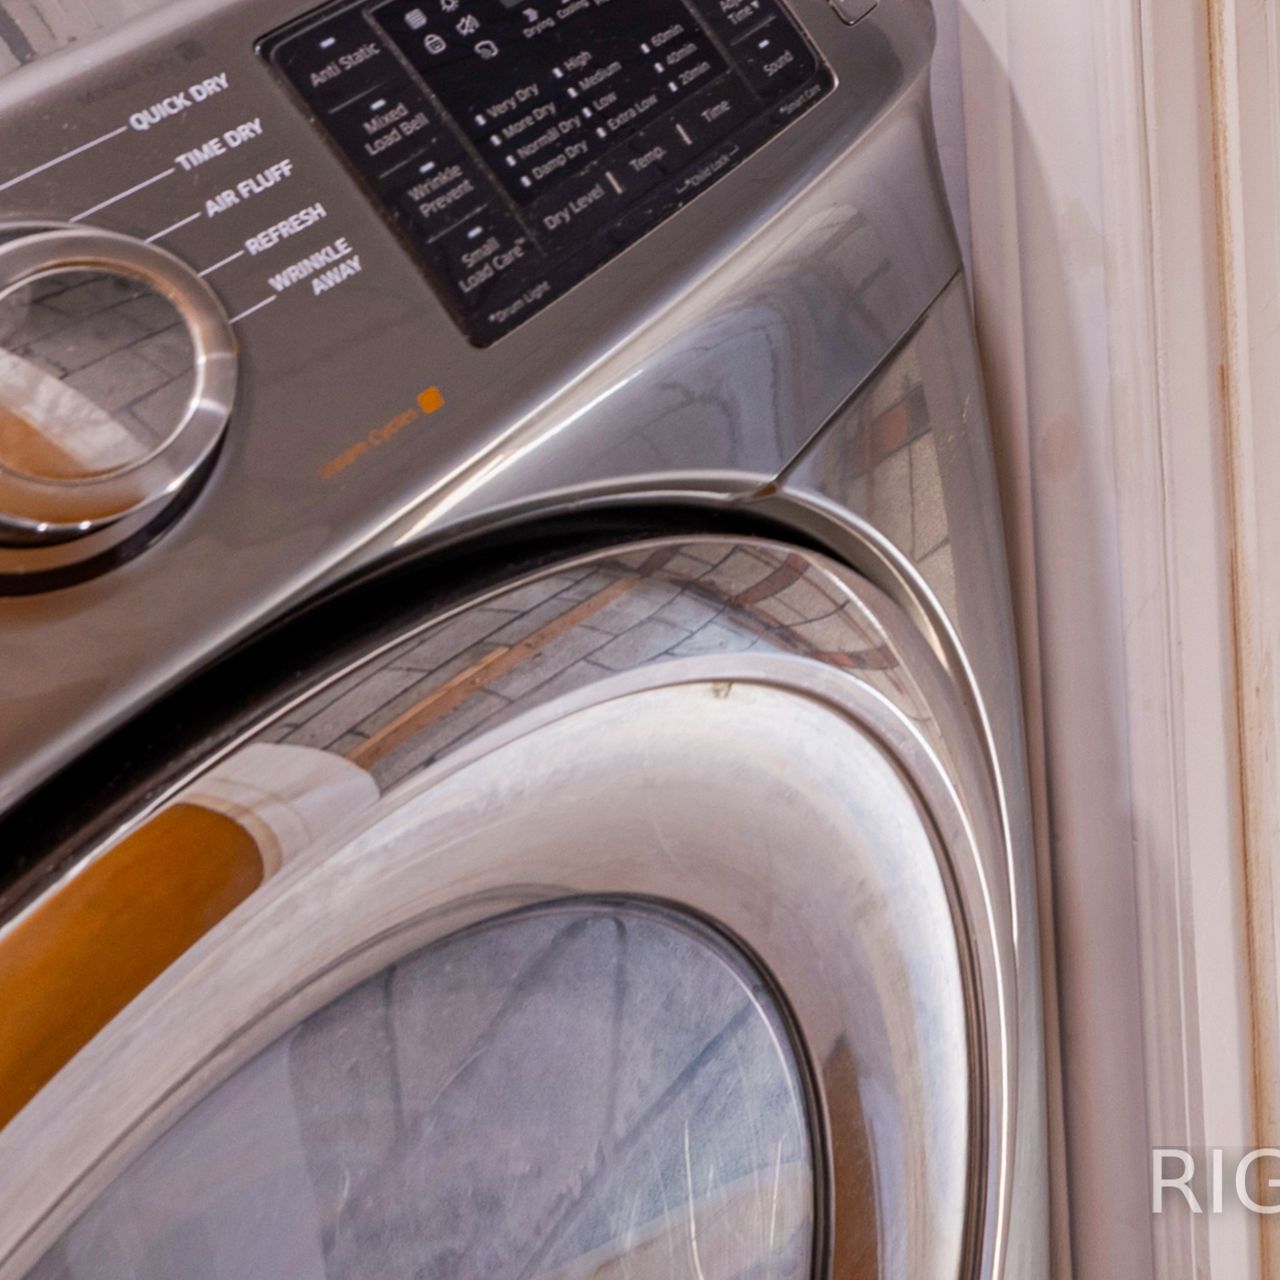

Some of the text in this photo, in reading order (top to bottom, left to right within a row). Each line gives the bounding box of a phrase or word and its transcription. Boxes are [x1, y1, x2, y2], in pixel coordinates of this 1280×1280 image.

[522, 17, 556, 39] Drying
[728, 6, 754, 26] Time
[650, 23, 684, 48] 60min
[309, 42, 381, 88] Anti Static
[563, 50, 593, 73] High
[665, 42, 698, 66] 40min
[763, 49, 795, 77] Sound
[577, 61, 623, 91] Medium
[677, 61, 712, 86] 20min
[128, 91, 192, 131] QUICK
[188, 72, 230, 103] DRY
[363, 102, 410, 136] Mixed
[486, 83, 540, 119] Very Dry
[592, 91, 618, 112] Low
[606, 94, 659, 132] Extra Low
[701, 99, 731, 123] Time
[364, 111, 430, 157] Load Bell
[501, 101, 557, 140] More Dry
[516, 114, 582, 160] Normal Dry
[174, 118, 264, 171] TIME DRY
[531, 139, 589, 181] Damp Dry
[629, 146, 667, 172] Temp.
[204, 158, 293, 218] AIR FLUFF
[407, 164, 464, 202] Wrinkle
[419, 179, 475, 218] Prevent
[543, 182, 605, 230] Dry Level
[244, 202, 328, 256] REFRESH
[268, 237, 353, 292] WRINKLE
[461, 236, 500, 269] Small
[311, 255, 362, 297] AWAY
[458, 263, 495, 293] Load
[523, 280, 551, 307] Light
